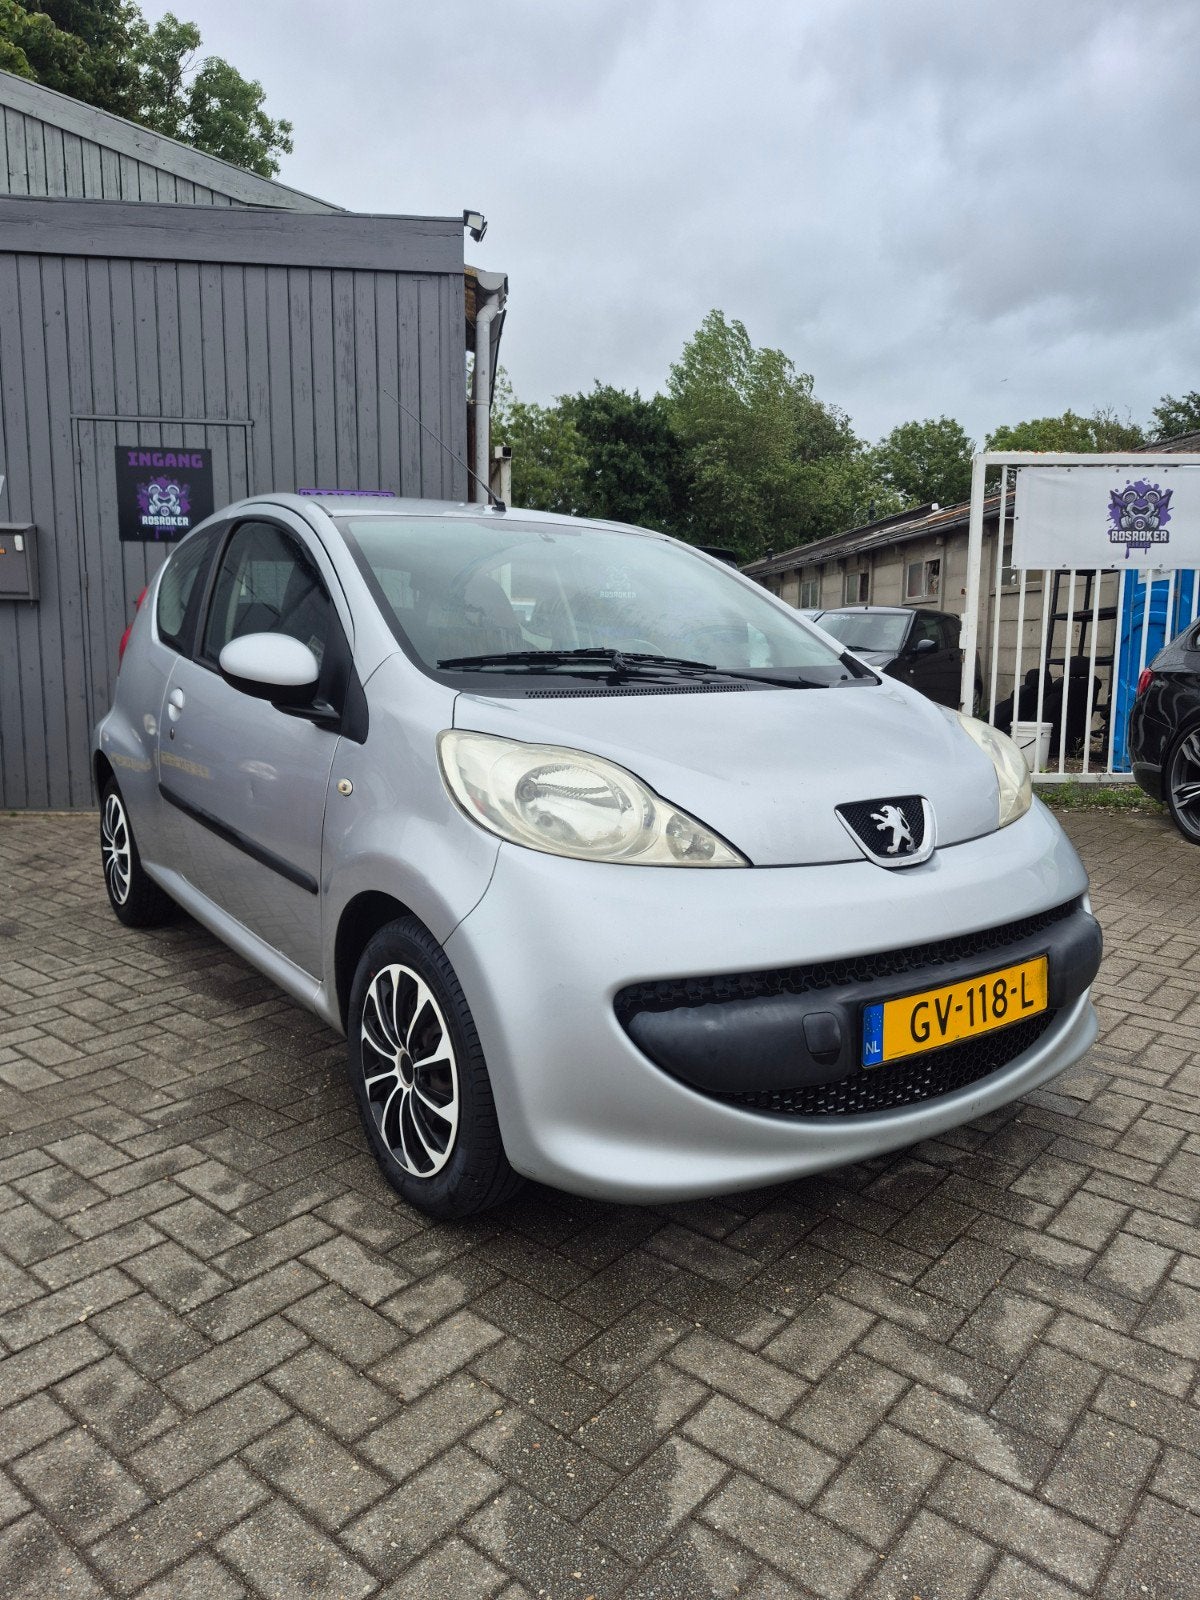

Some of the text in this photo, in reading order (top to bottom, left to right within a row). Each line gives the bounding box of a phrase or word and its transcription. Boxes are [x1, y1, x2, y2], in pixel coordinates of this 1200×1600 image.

[128, 452, 203, 468] INGANG
[142, 515, 189, 526] ROSROKER
[1111, 530, 1168, 542] ROSROKER
[910, 972, 1034, 1043] GV-118-L
[865, 1040, 881, 1055] NL
